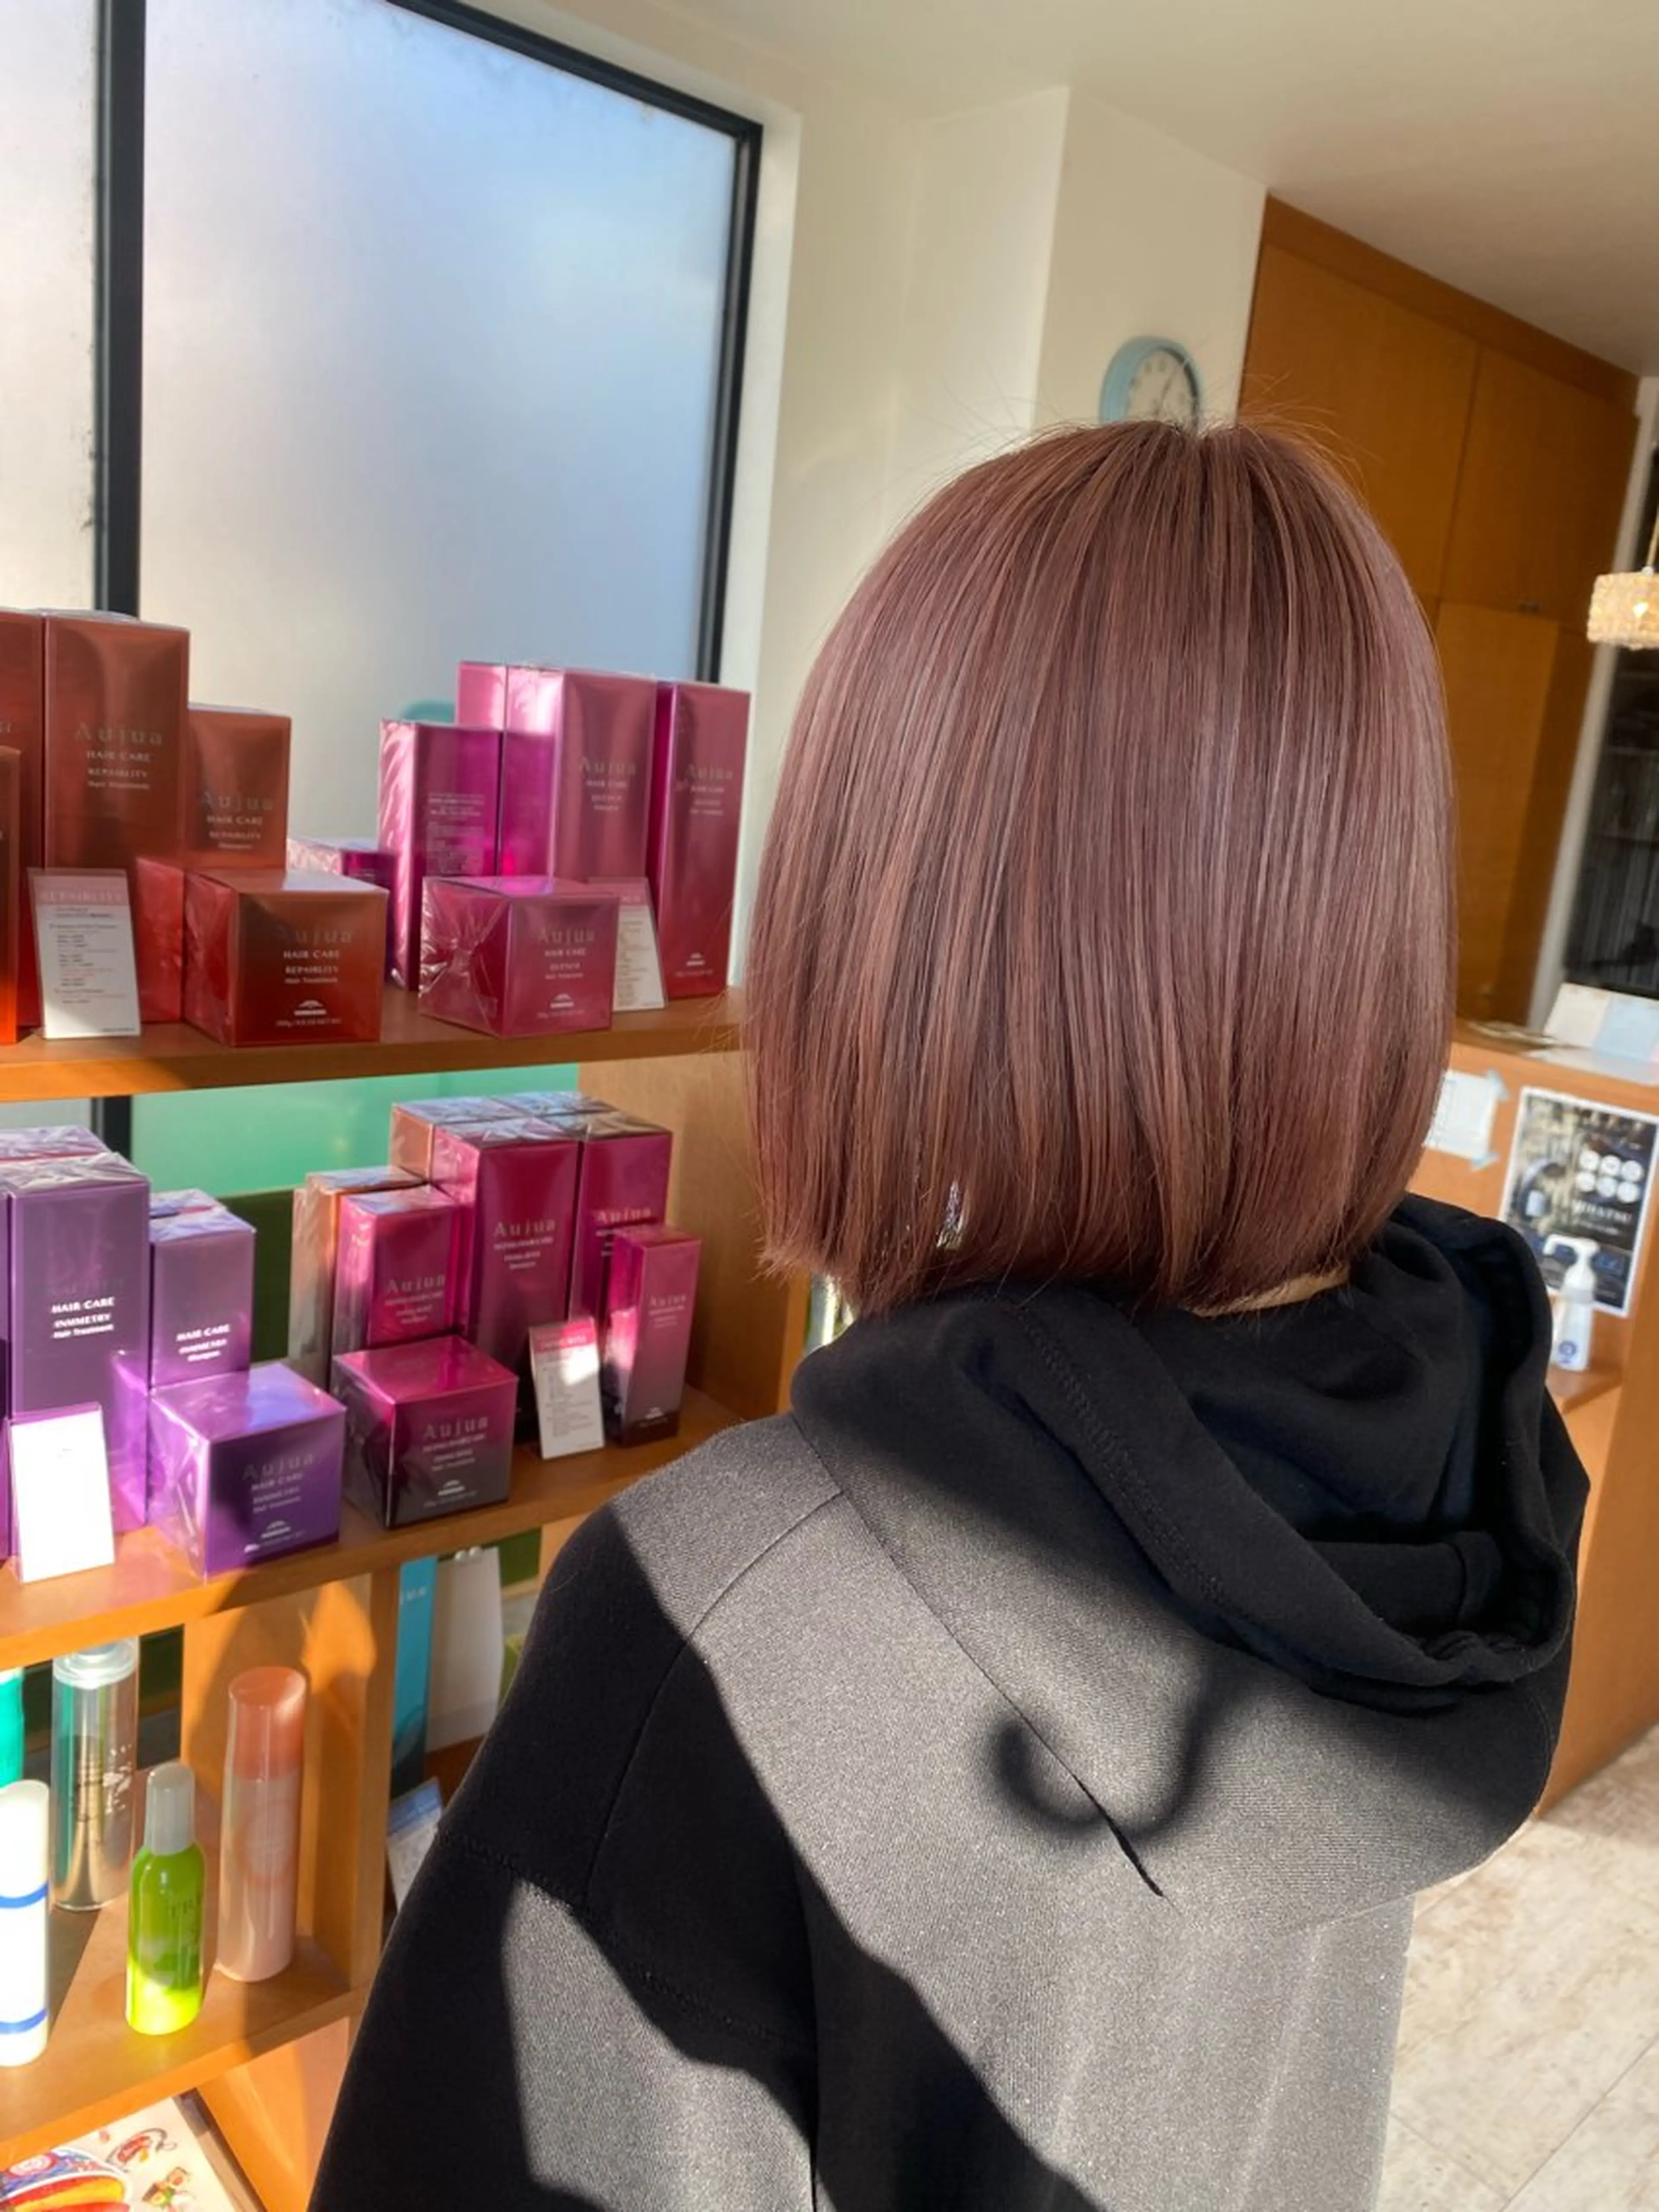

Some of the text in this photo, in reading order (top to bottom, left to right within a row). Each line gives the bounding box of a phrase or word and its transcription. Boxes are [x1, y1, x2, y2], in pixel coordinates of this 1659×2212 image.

[283, 950, 340, 959] HAIR CARE
[493, 1219, 556, 1238] Aujua
[51, 1296, 115, 1314] HAIR CARE
[176, 1324, 231, 1342] HAIR CARE
